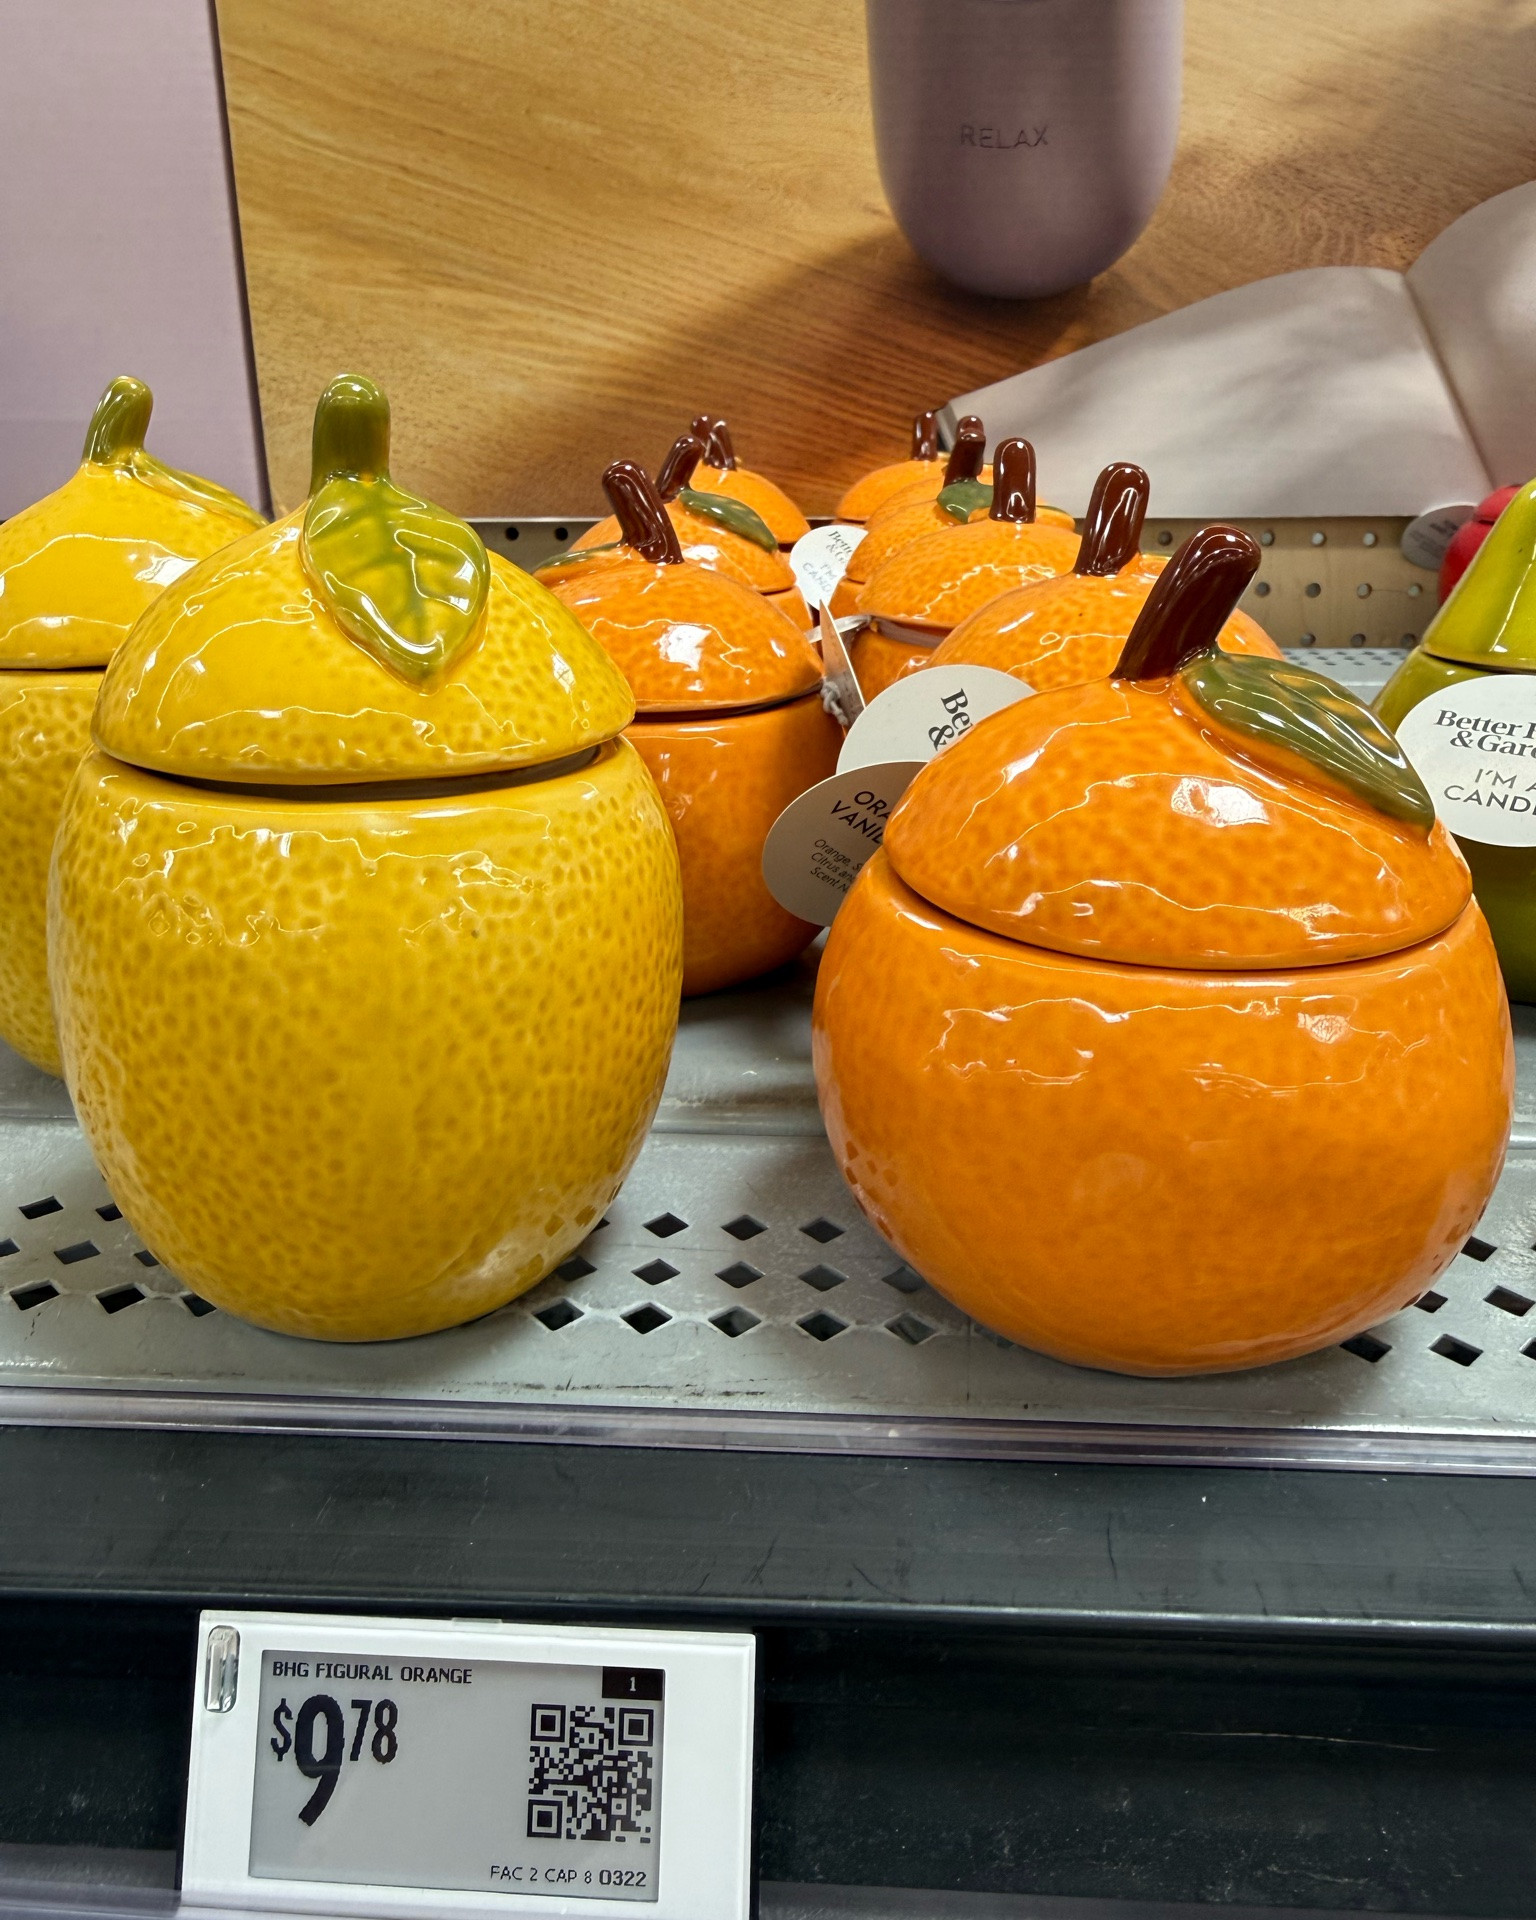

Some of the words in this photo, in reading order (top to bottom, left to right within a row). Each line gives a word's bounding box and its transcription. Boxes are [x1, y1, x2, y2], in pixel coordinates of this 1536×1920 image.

[960, 124, 1048, 149] RELAX
[1433, 709, 1523, 737] Better
[928, 724, 955, 751] &
[1475, 769, 1517, 789] I'M
[811, 852, 840, 873] Citrus
[810, 866, 840, 887] Scent
[272, 1661, 309, 1678] BHG
[315, 1663, 393, 1681] FIGURAL
[400, 1666, 473, 1684] ORANGE
[629, 1676, 637, 1692] 1
[490, 1865, 523, 1881] FAC
[529, 1867, 538, 1882] 2
[544, 1868, 578, 1884] CAP
[584, 1870, 592, 1884] 8
[599, 1869, 647, 1888] 0322
